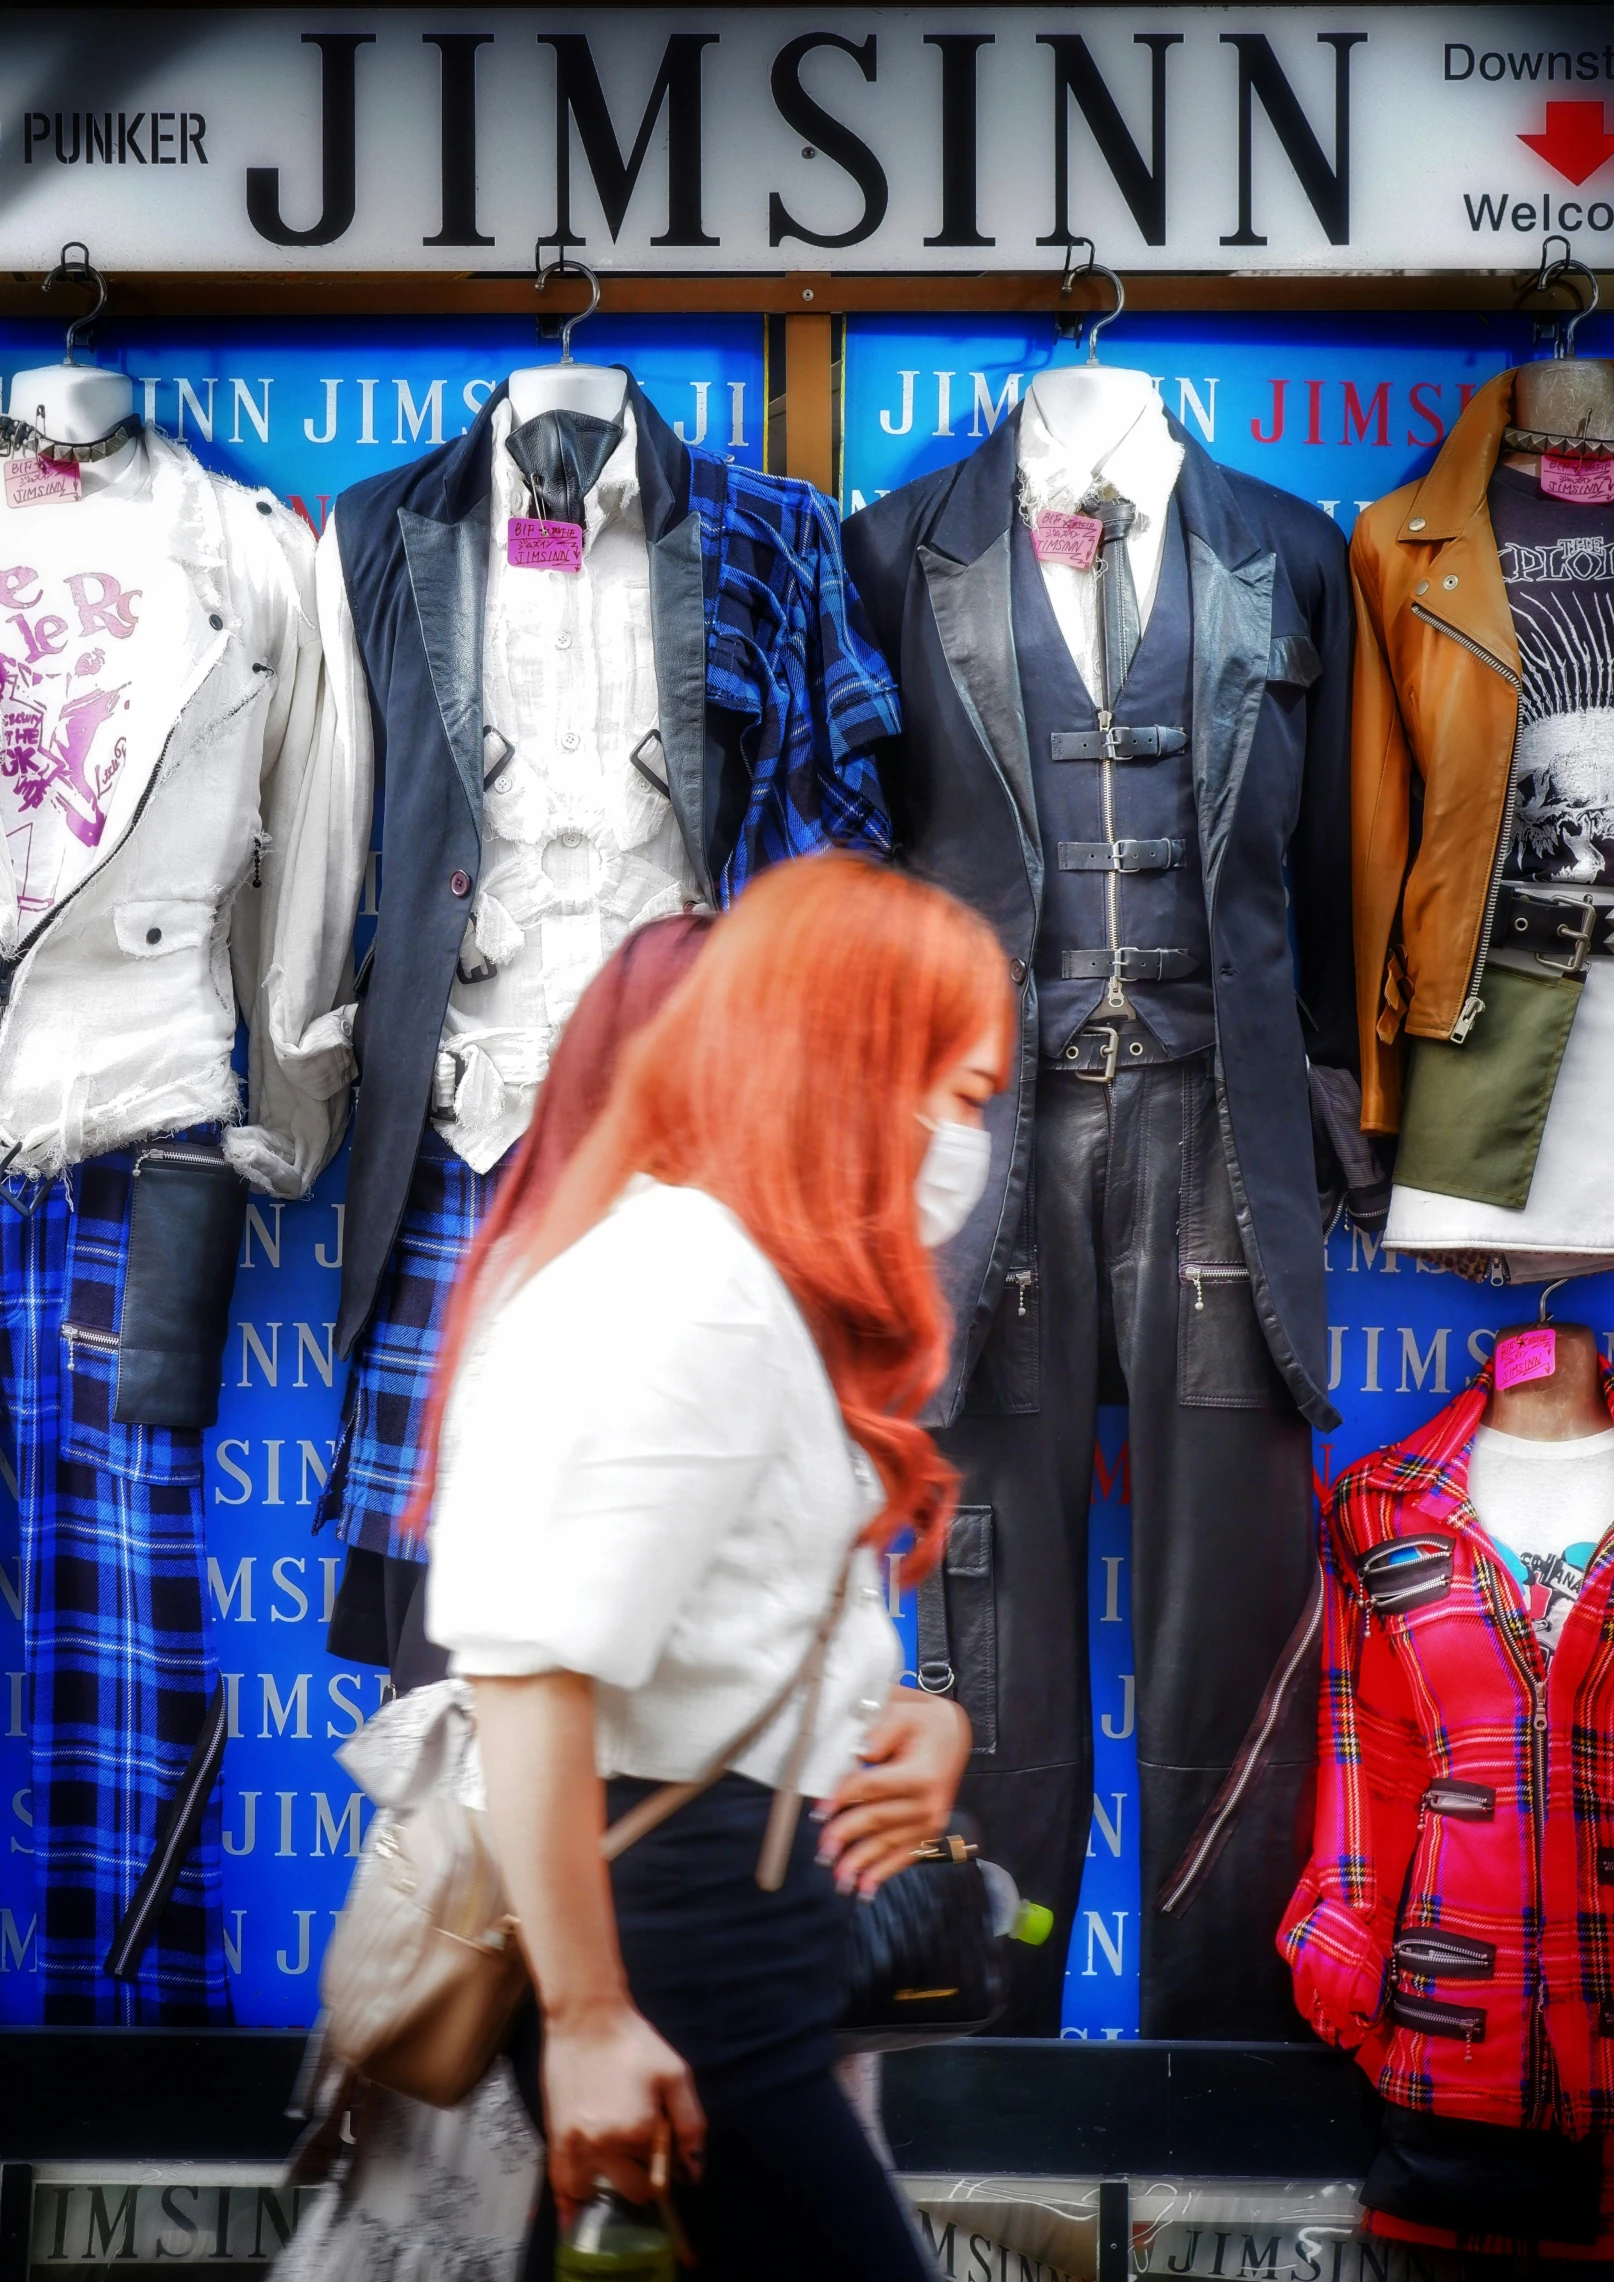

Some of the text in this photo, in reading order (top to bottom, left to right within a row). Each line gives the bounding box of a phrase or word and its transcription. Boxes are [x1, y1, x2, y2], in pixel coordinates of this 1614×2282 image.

[23, 112, 208, 165] PUNKER
[246, 32, 1368, 249] JIMSINN
[1463, 193, 1614, 232] Welco
[1548, 481, 1604, 494] JIMSINN
[514, 550, 570, 564] JIMSINN
